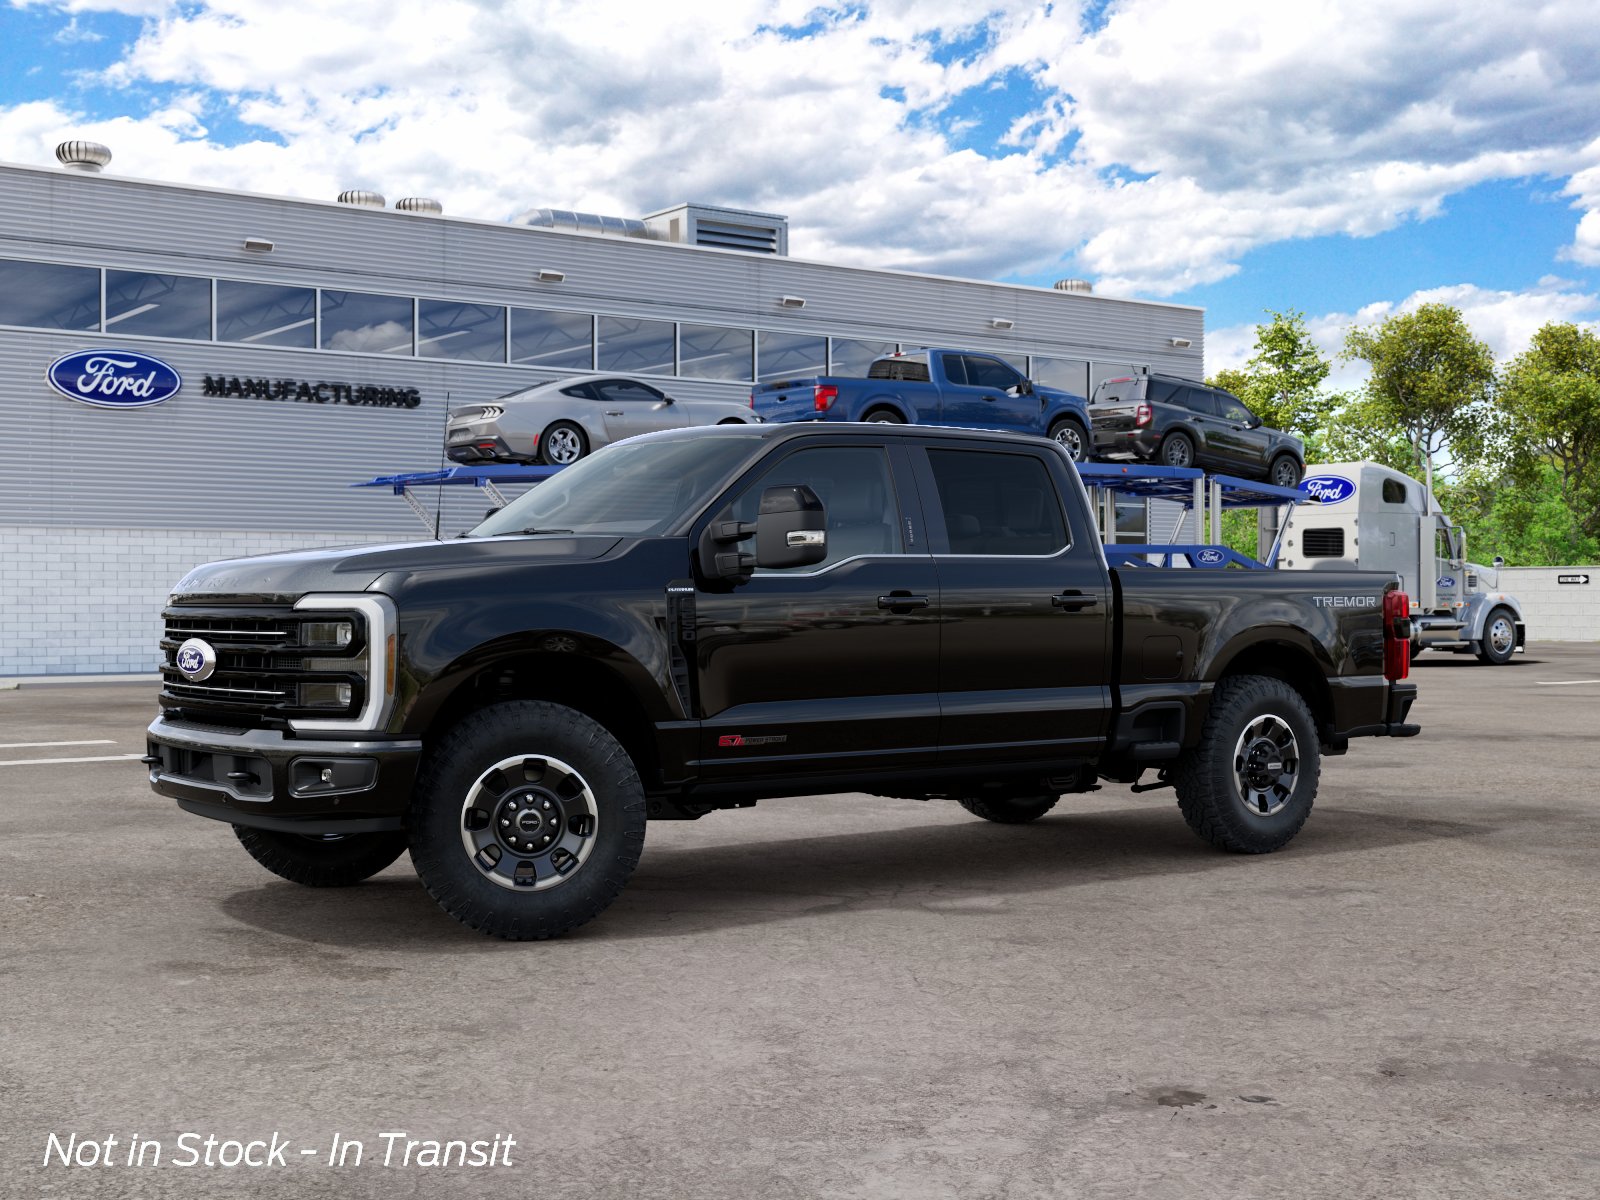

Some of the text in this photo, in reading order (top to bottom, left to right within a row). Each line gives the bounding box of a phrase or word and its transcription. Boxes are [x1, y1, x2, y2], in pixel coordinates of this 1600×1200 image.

[76, 356, 156, 398] Ford
[203, 374, 421, 408] MANUFACTURING
[1306, 480, 1343, 499] Ford
[1312, 596, 1376, 607] TREMOR
[181, 650, 199, 669] Ford
